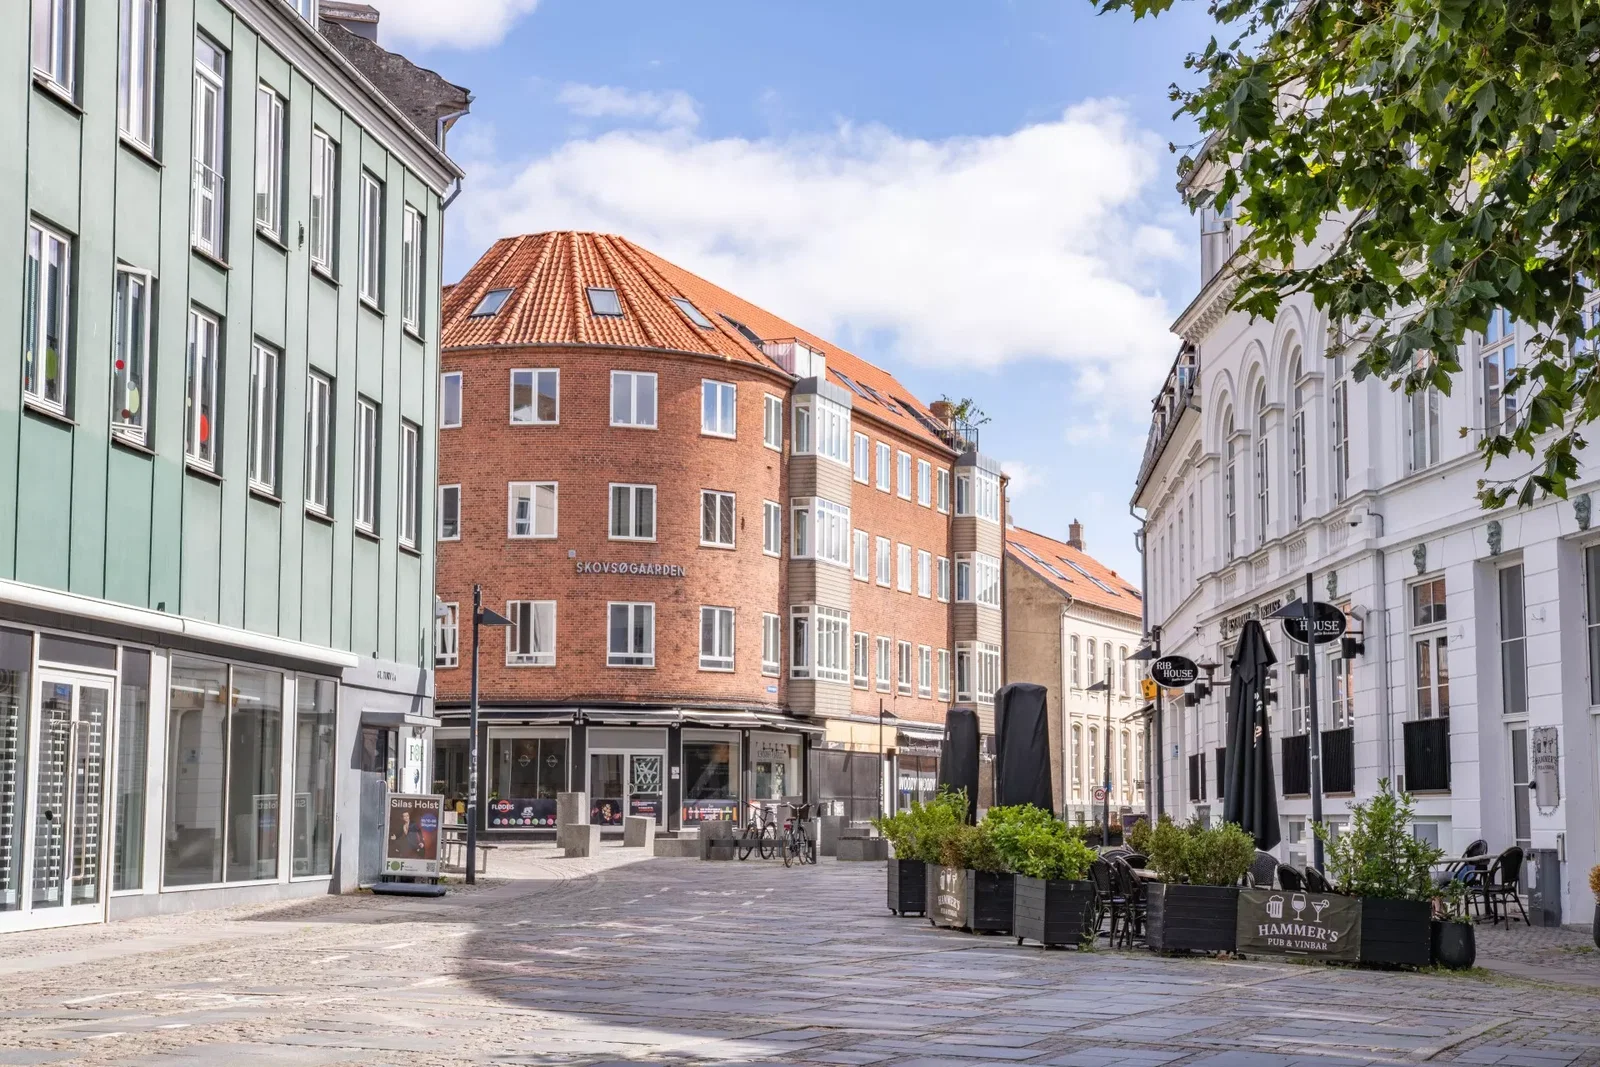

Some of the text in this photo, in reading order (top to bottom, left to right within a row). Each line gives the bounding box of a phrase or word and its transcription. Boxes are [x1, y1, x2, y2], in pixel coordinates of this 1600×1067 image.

[576, 561, 686, 577] SKOVSØGAARDEN
[1156, 661, 1172, 670] RIB
[1163, 669, 1194, 678] HOUSE
[391, 799, 439, 809] Silas Holst
[1258, 923, 1339, 943] HAMMER'S
[1267, 937, 1328, 951] PUB & VINBAR
